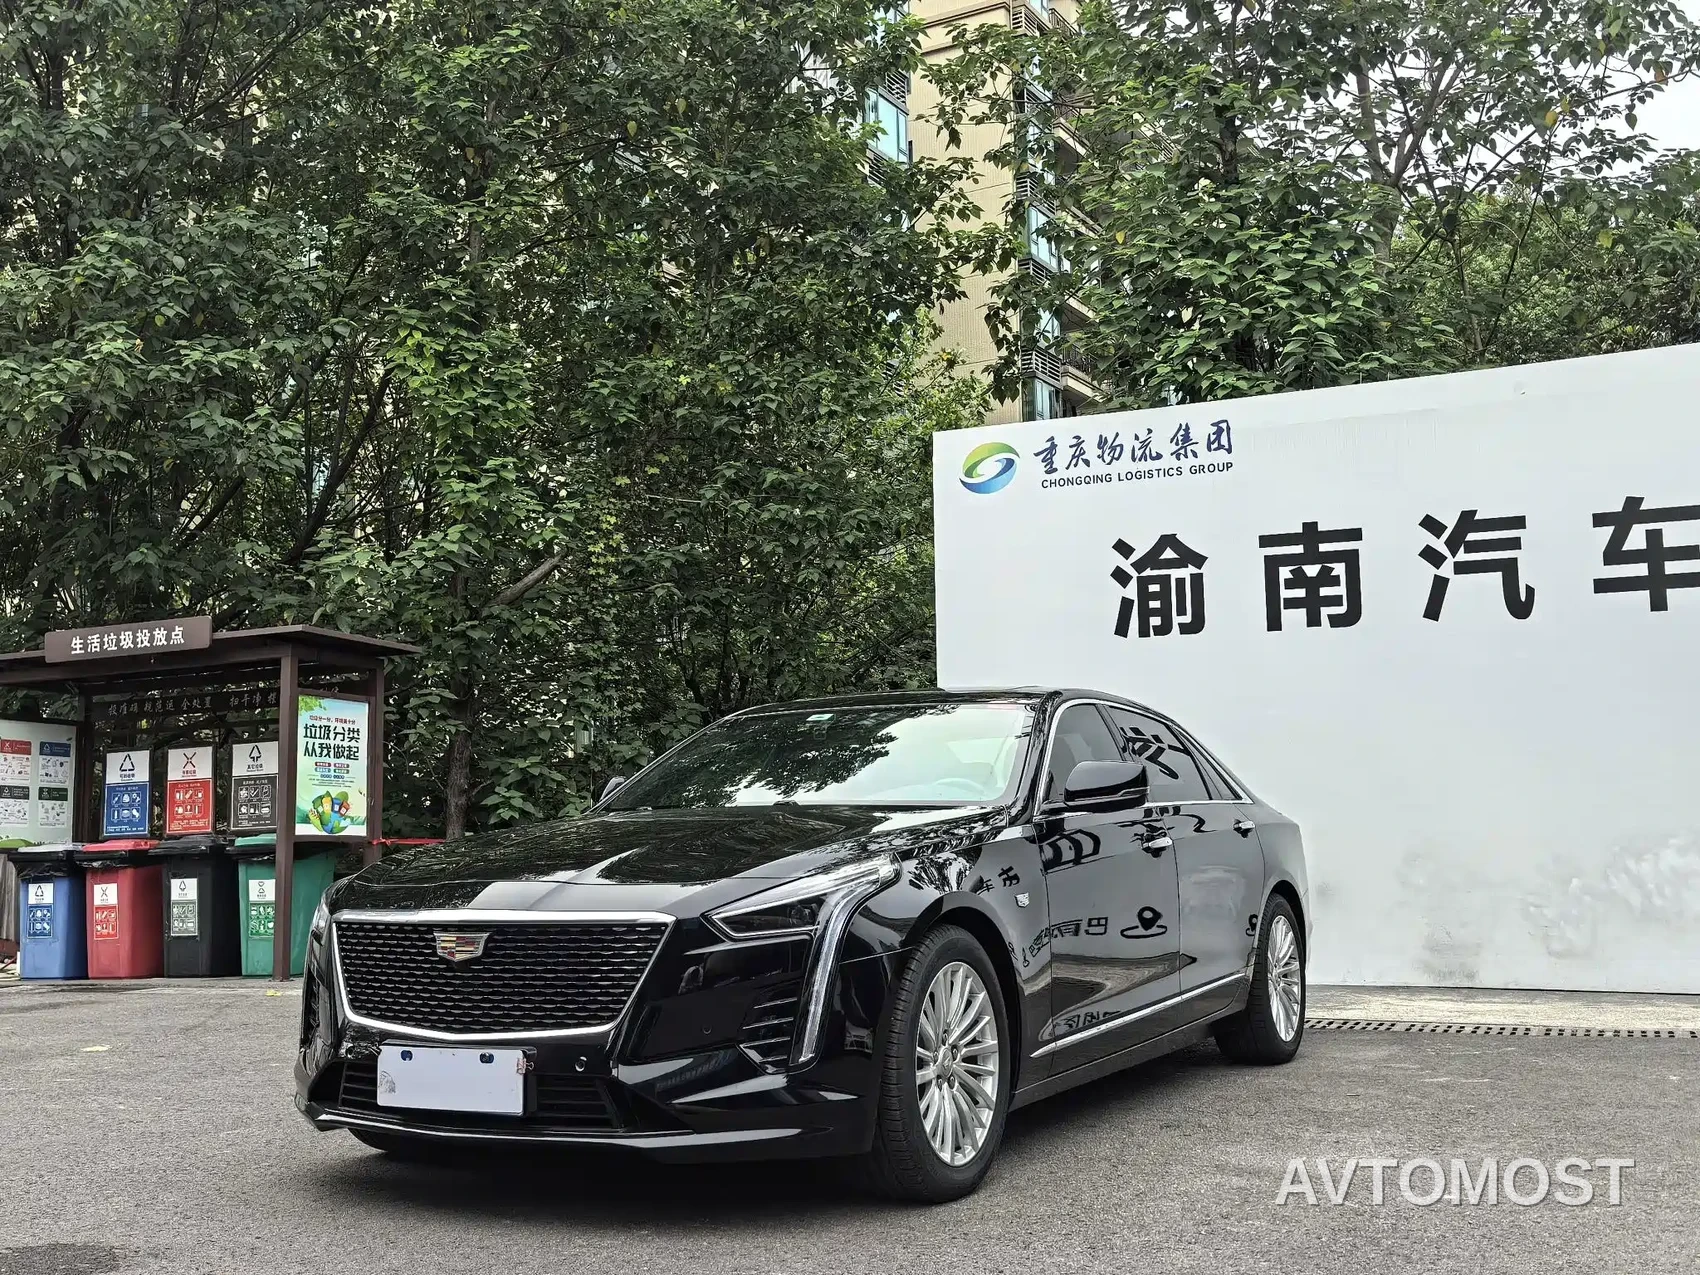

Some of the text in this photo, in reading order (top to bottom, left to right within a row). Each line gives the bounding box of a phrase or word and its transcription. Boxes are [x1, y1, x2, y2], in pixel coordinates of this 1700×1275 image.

[1033, 419, 1233, 475] 重庆物流集团
[1041, 461, 1234, 489] CHONGQING LOGISTICS GROUP
[1110, 496, 1700, 638] 渝南汽车
[70, 625, 185, 655] 生活垃圾投放点
[303, 723, 361, 743] 垃圾分类
[303, 741, 360, 761] 从我做起
